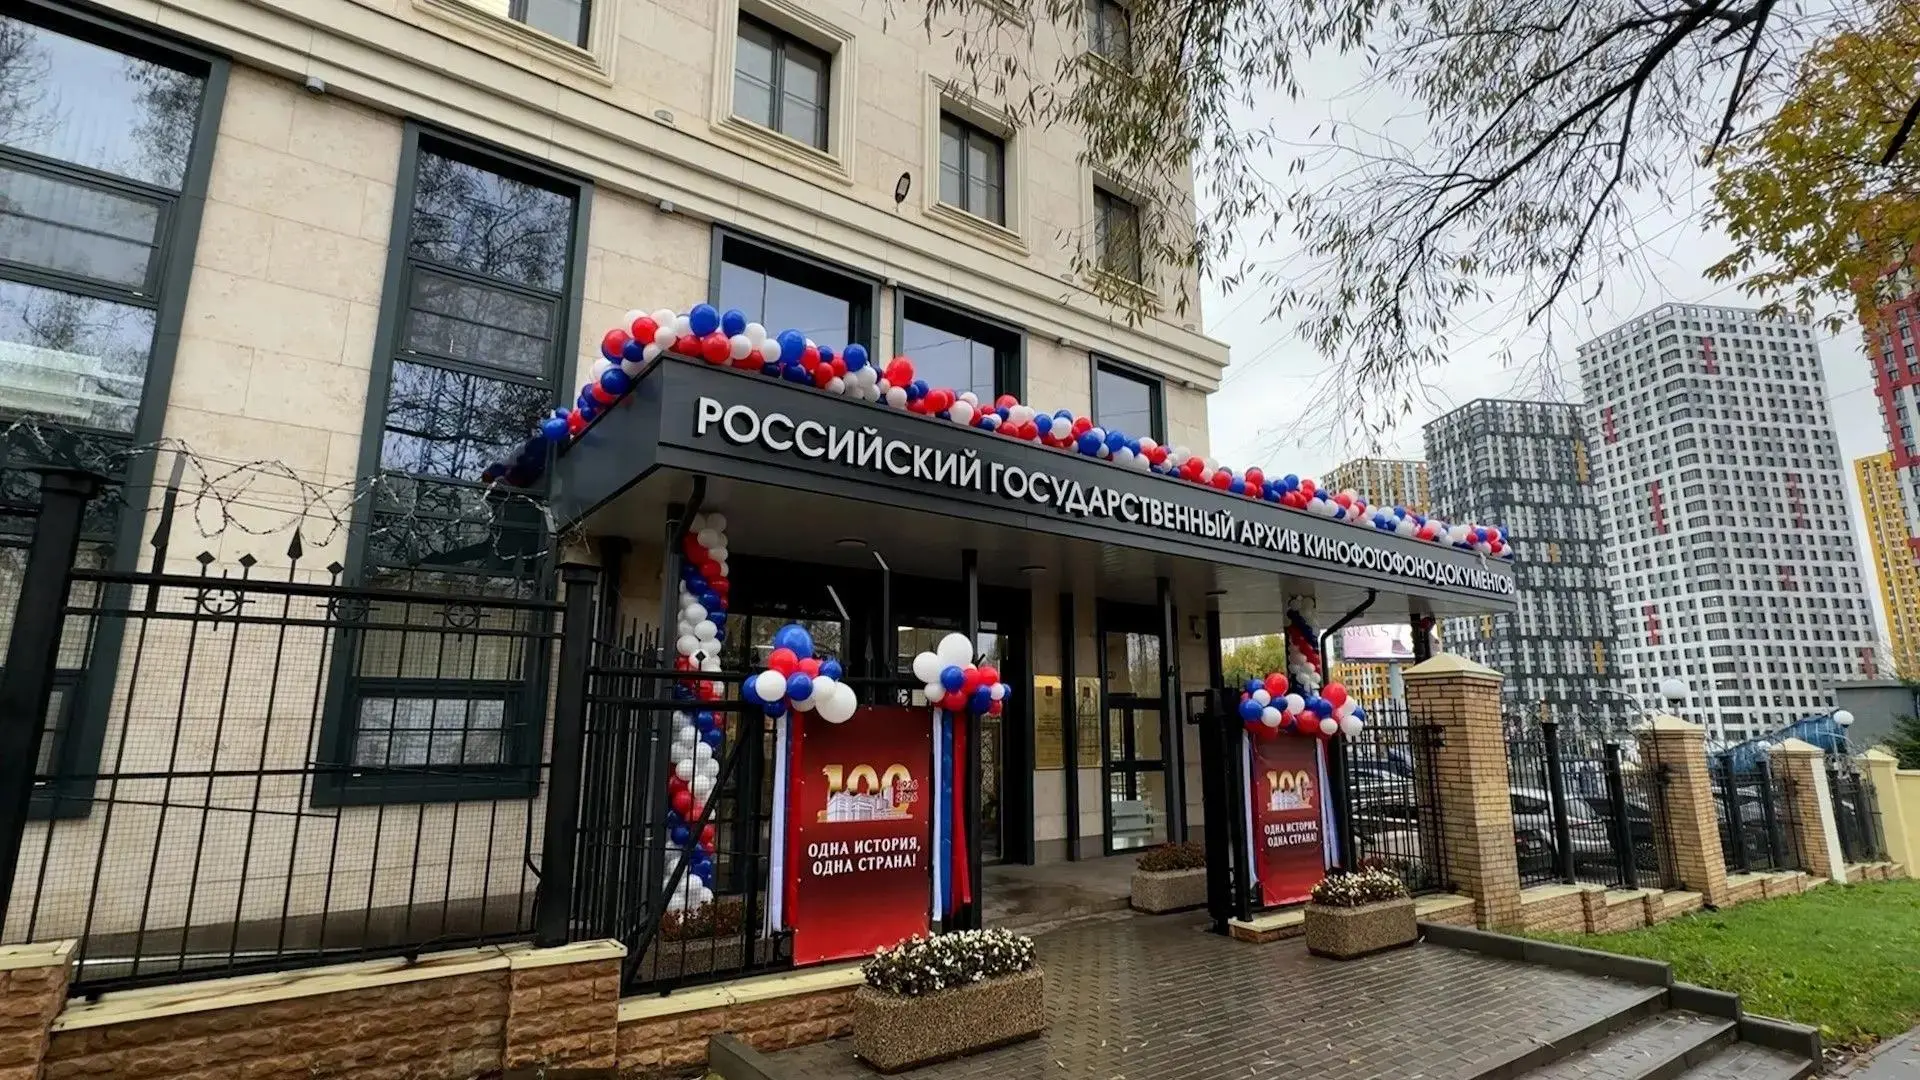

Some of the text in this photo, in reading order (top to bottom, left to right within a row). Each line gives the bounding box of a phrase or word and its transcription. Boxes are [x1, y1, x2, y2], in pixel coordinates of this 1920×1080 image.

[697, 396, 1515, 595] РОССИЙСКИЙ ГОСУДАРСТВЕННЫЙ АРХИВ КИНОФОТОФОНОДОКУМЕНТОВ
[819, 764, 913, 823] 100
[1266, 770, 1312, 811] 100
[1264, 824, 1285, 835] ОДНА
[1267, 832, 1317, 847] ОДНА СТРАНА!
[808, 837, 921, 858] ОДНА ИСТОРИЯ,
[812, 854, 916, 876] ОДНА СТРАНА!
